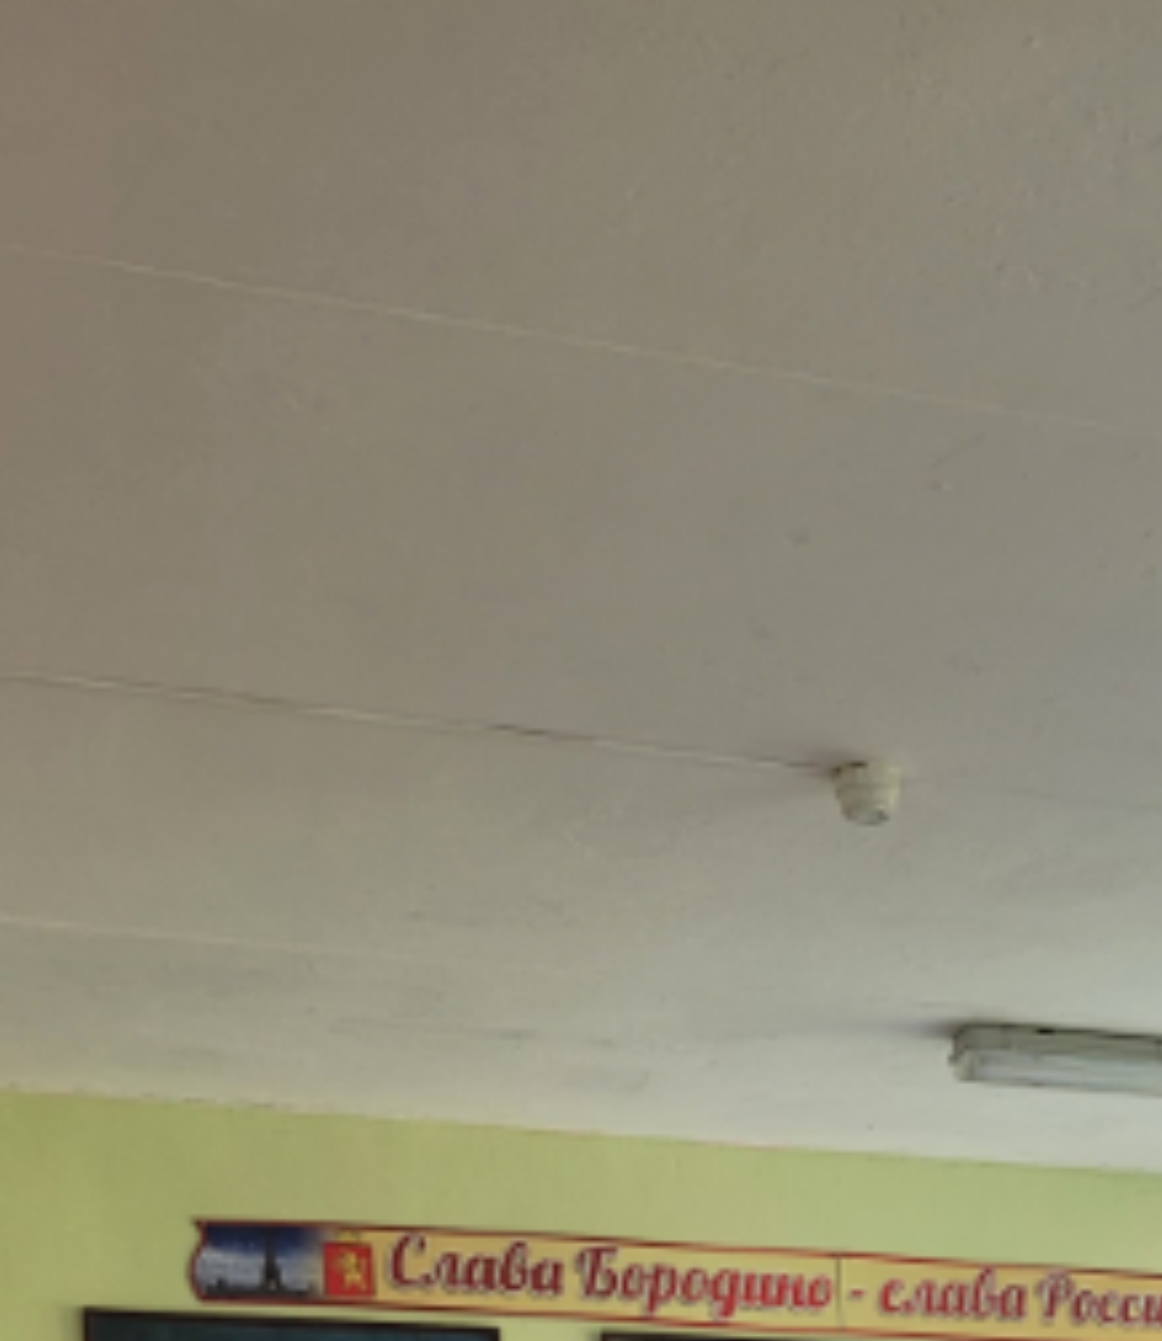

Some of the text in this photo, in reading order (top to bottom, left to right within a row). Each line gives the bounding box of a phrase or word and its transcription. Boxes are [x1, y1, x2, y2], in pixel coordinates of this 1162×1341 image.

[389, 1232, 564, 1297] Слава
[576, 1245, 833, 1320] Бородино
[878, 1264, 1028, 1320] слава
